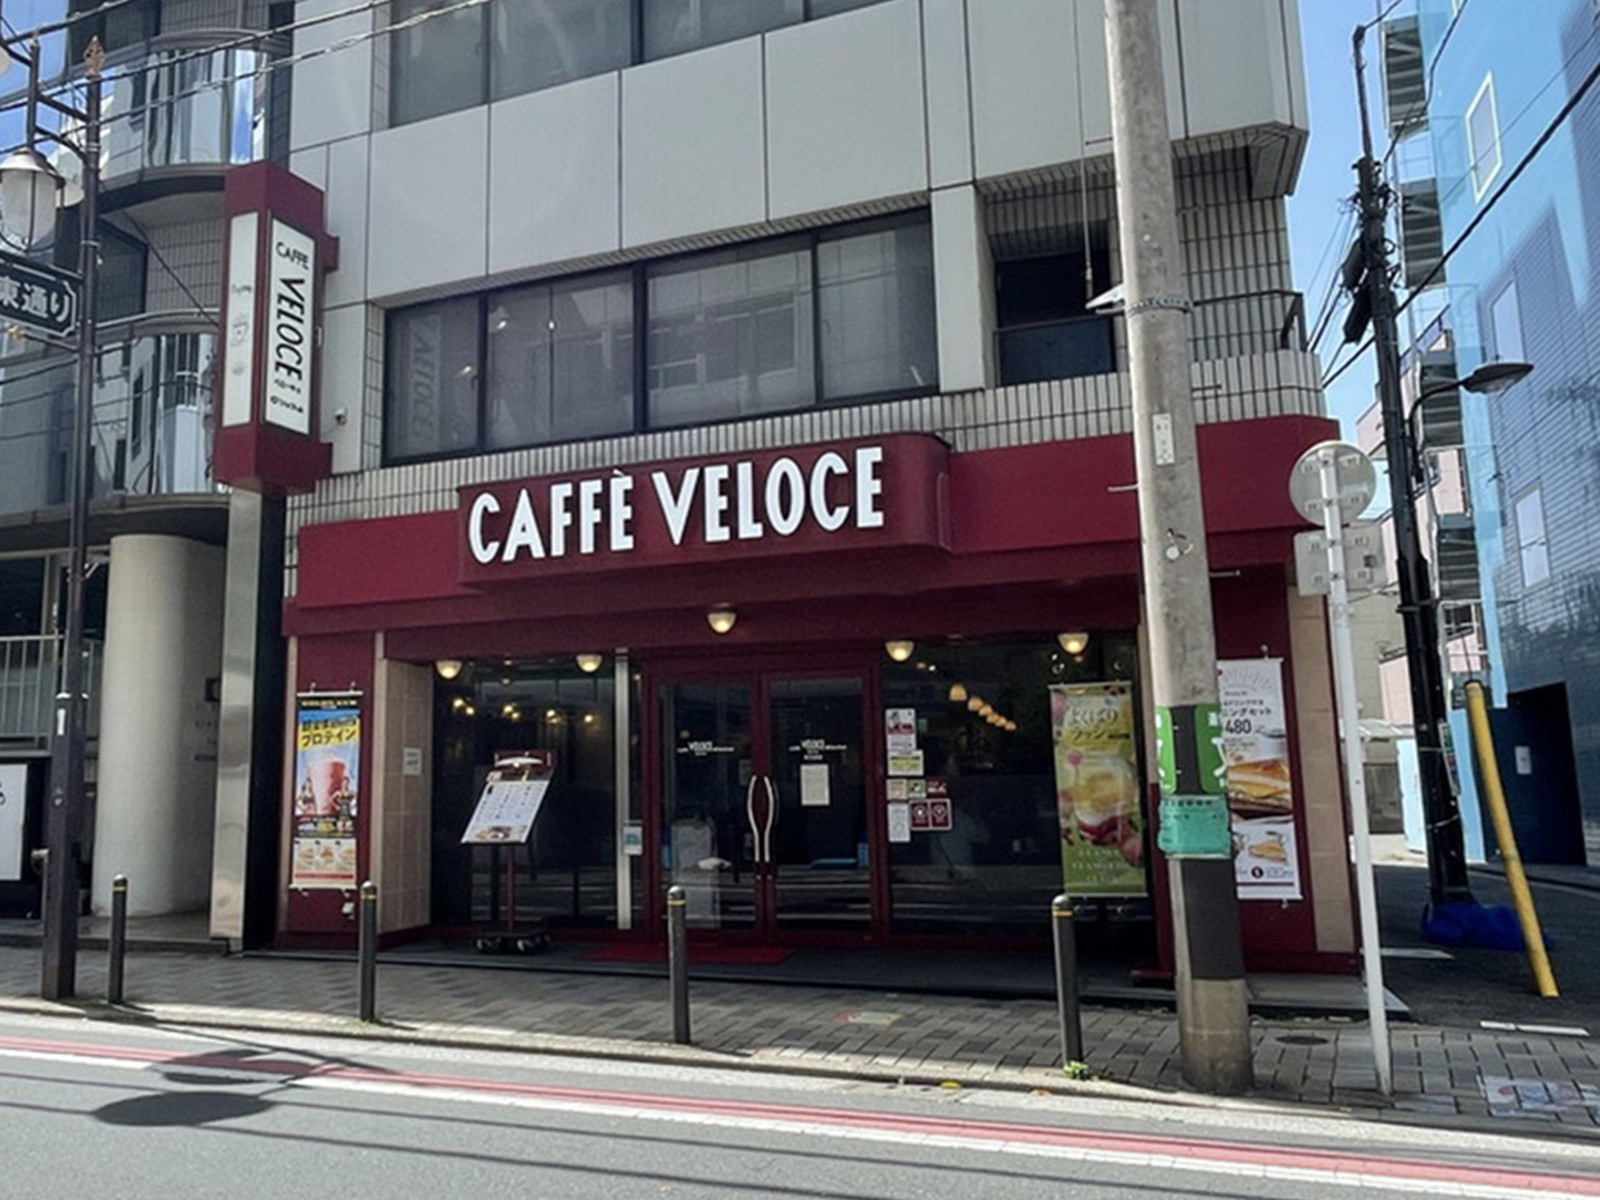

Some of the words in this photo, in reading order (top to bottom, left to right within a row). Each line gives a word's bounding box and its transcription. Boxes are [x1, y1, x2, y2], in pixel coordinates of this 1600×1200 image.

[274, 276, 306, 381] VELOCE
[468, 468, 634, 564] CAFFÈ
[652, 446, 884, 546] VELOCE
[302, 728, 356, 747] プロテイン
[1225, 718, 1252, 734] 480
